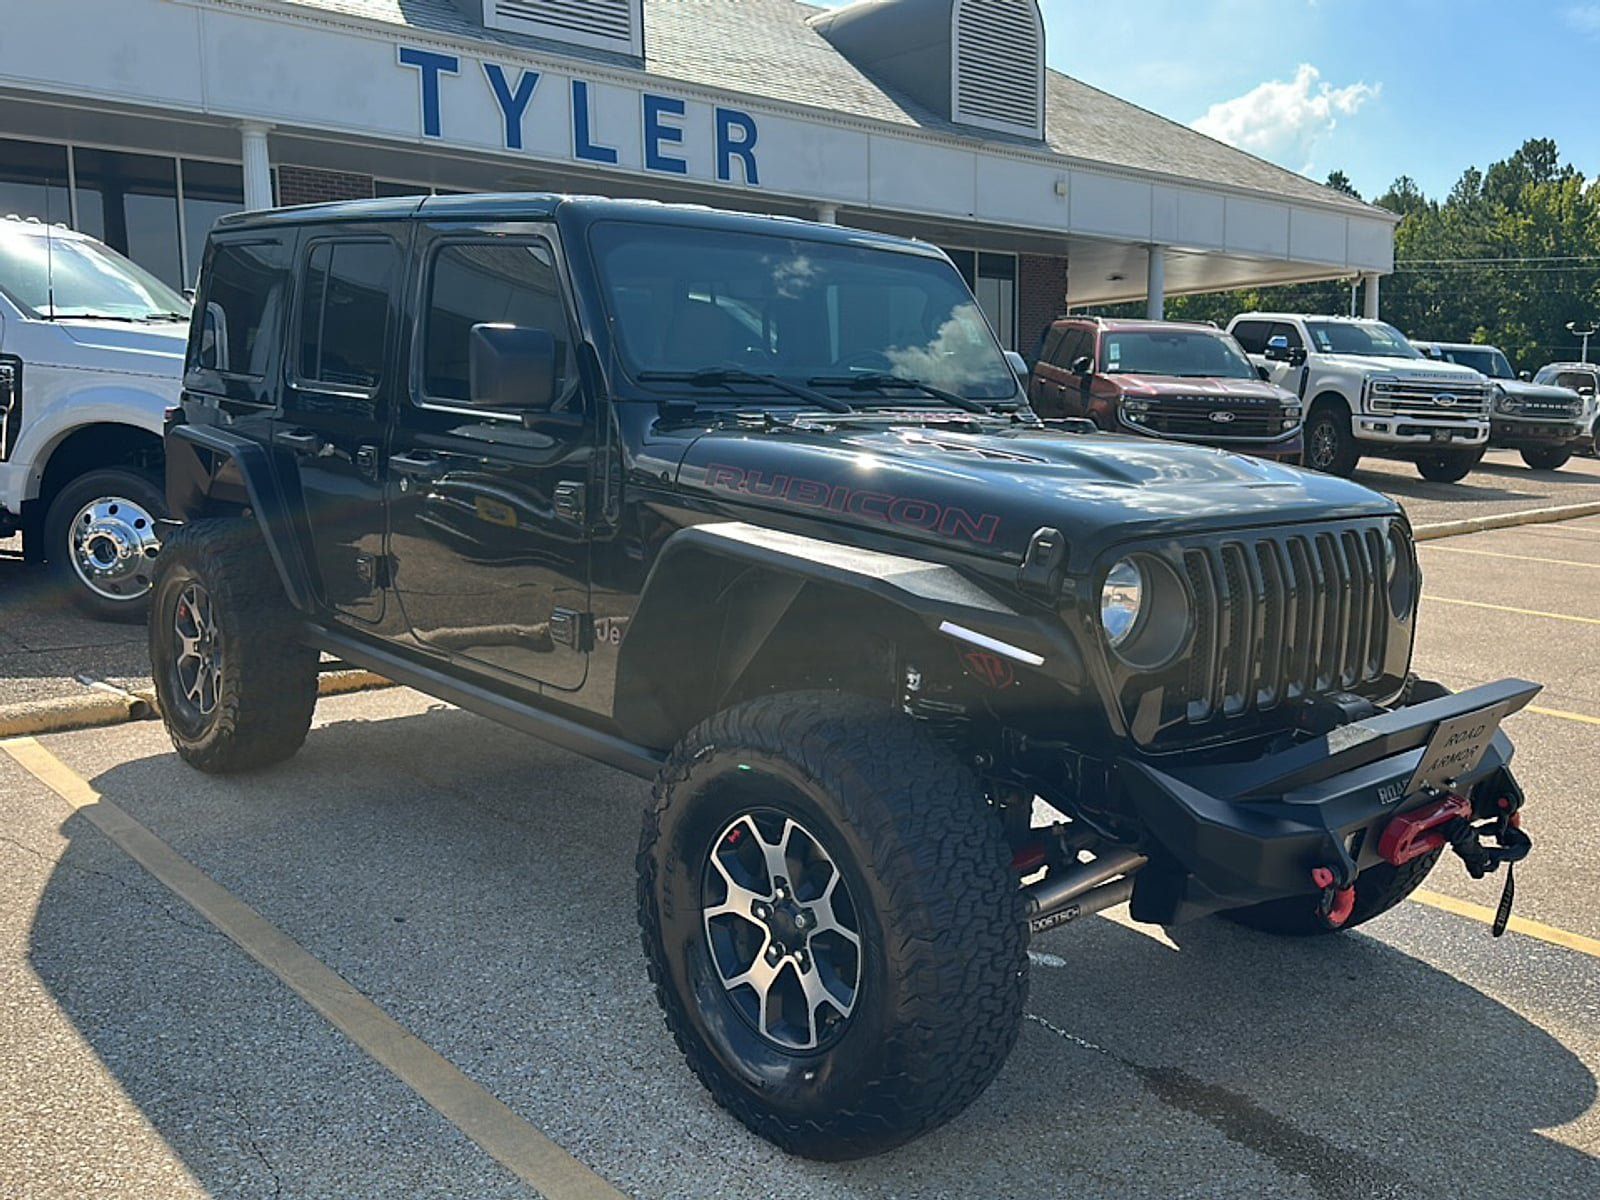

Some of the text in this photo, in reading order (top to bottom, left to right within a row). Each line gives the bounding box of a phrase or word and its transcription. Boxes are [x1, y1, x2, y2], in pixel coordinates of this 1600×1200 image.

[398, 46, 760, 185] TYLER
[703, 462, 1000, 544] RUBICON
[597, 620, 620, 645] Je
[1443, 725, 1486, 748] ROAD
